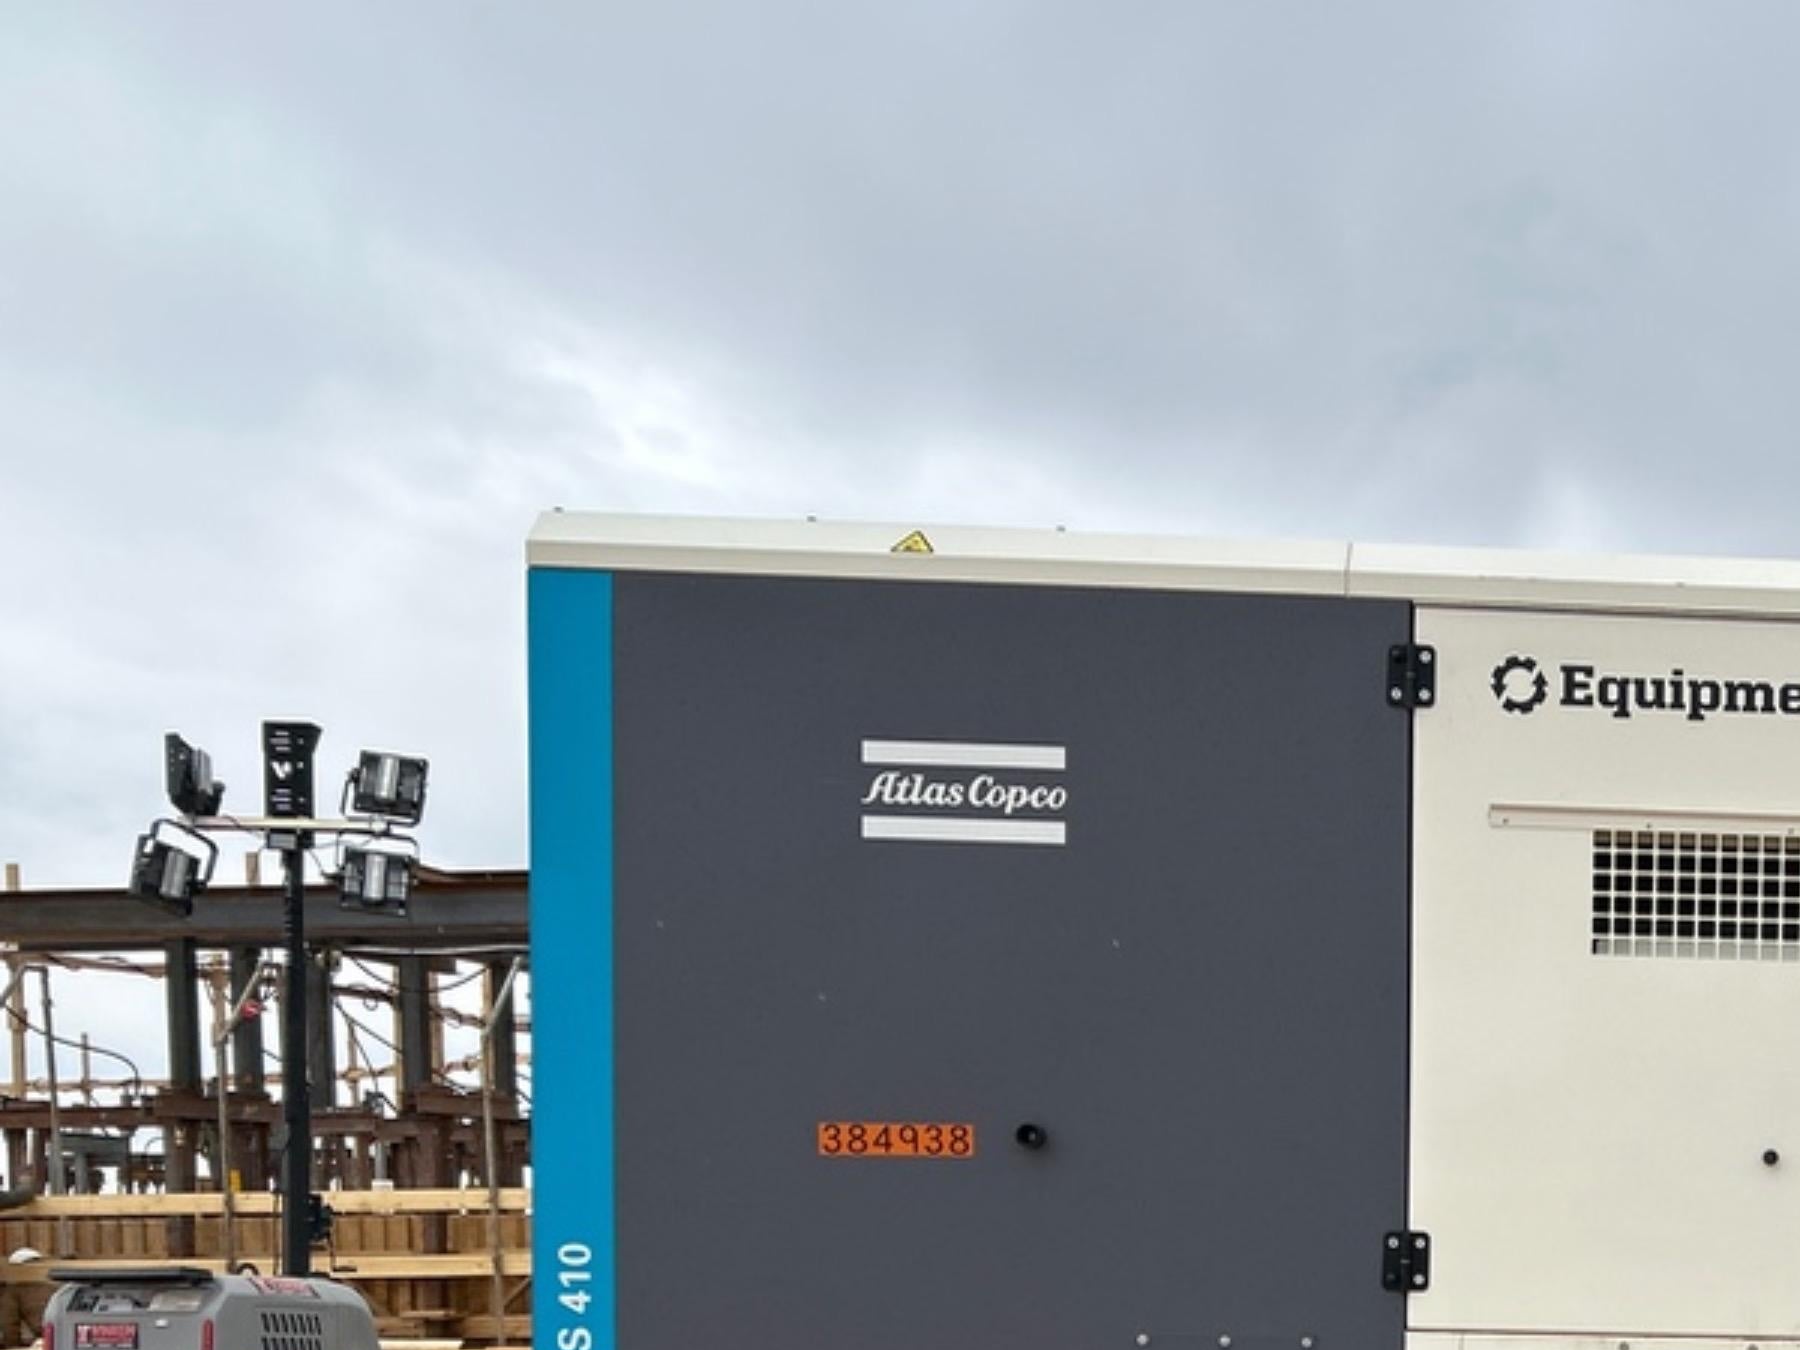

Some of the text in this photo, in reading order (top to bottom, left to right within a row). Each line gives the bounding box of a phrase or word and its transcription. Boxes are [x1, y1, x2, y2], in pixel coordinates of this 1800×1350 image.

[861, 770, 1067, 813] Atlas Copco
[822, 1124, 971, 1155] 384938
[557, 1242, 592, 1315] 410
